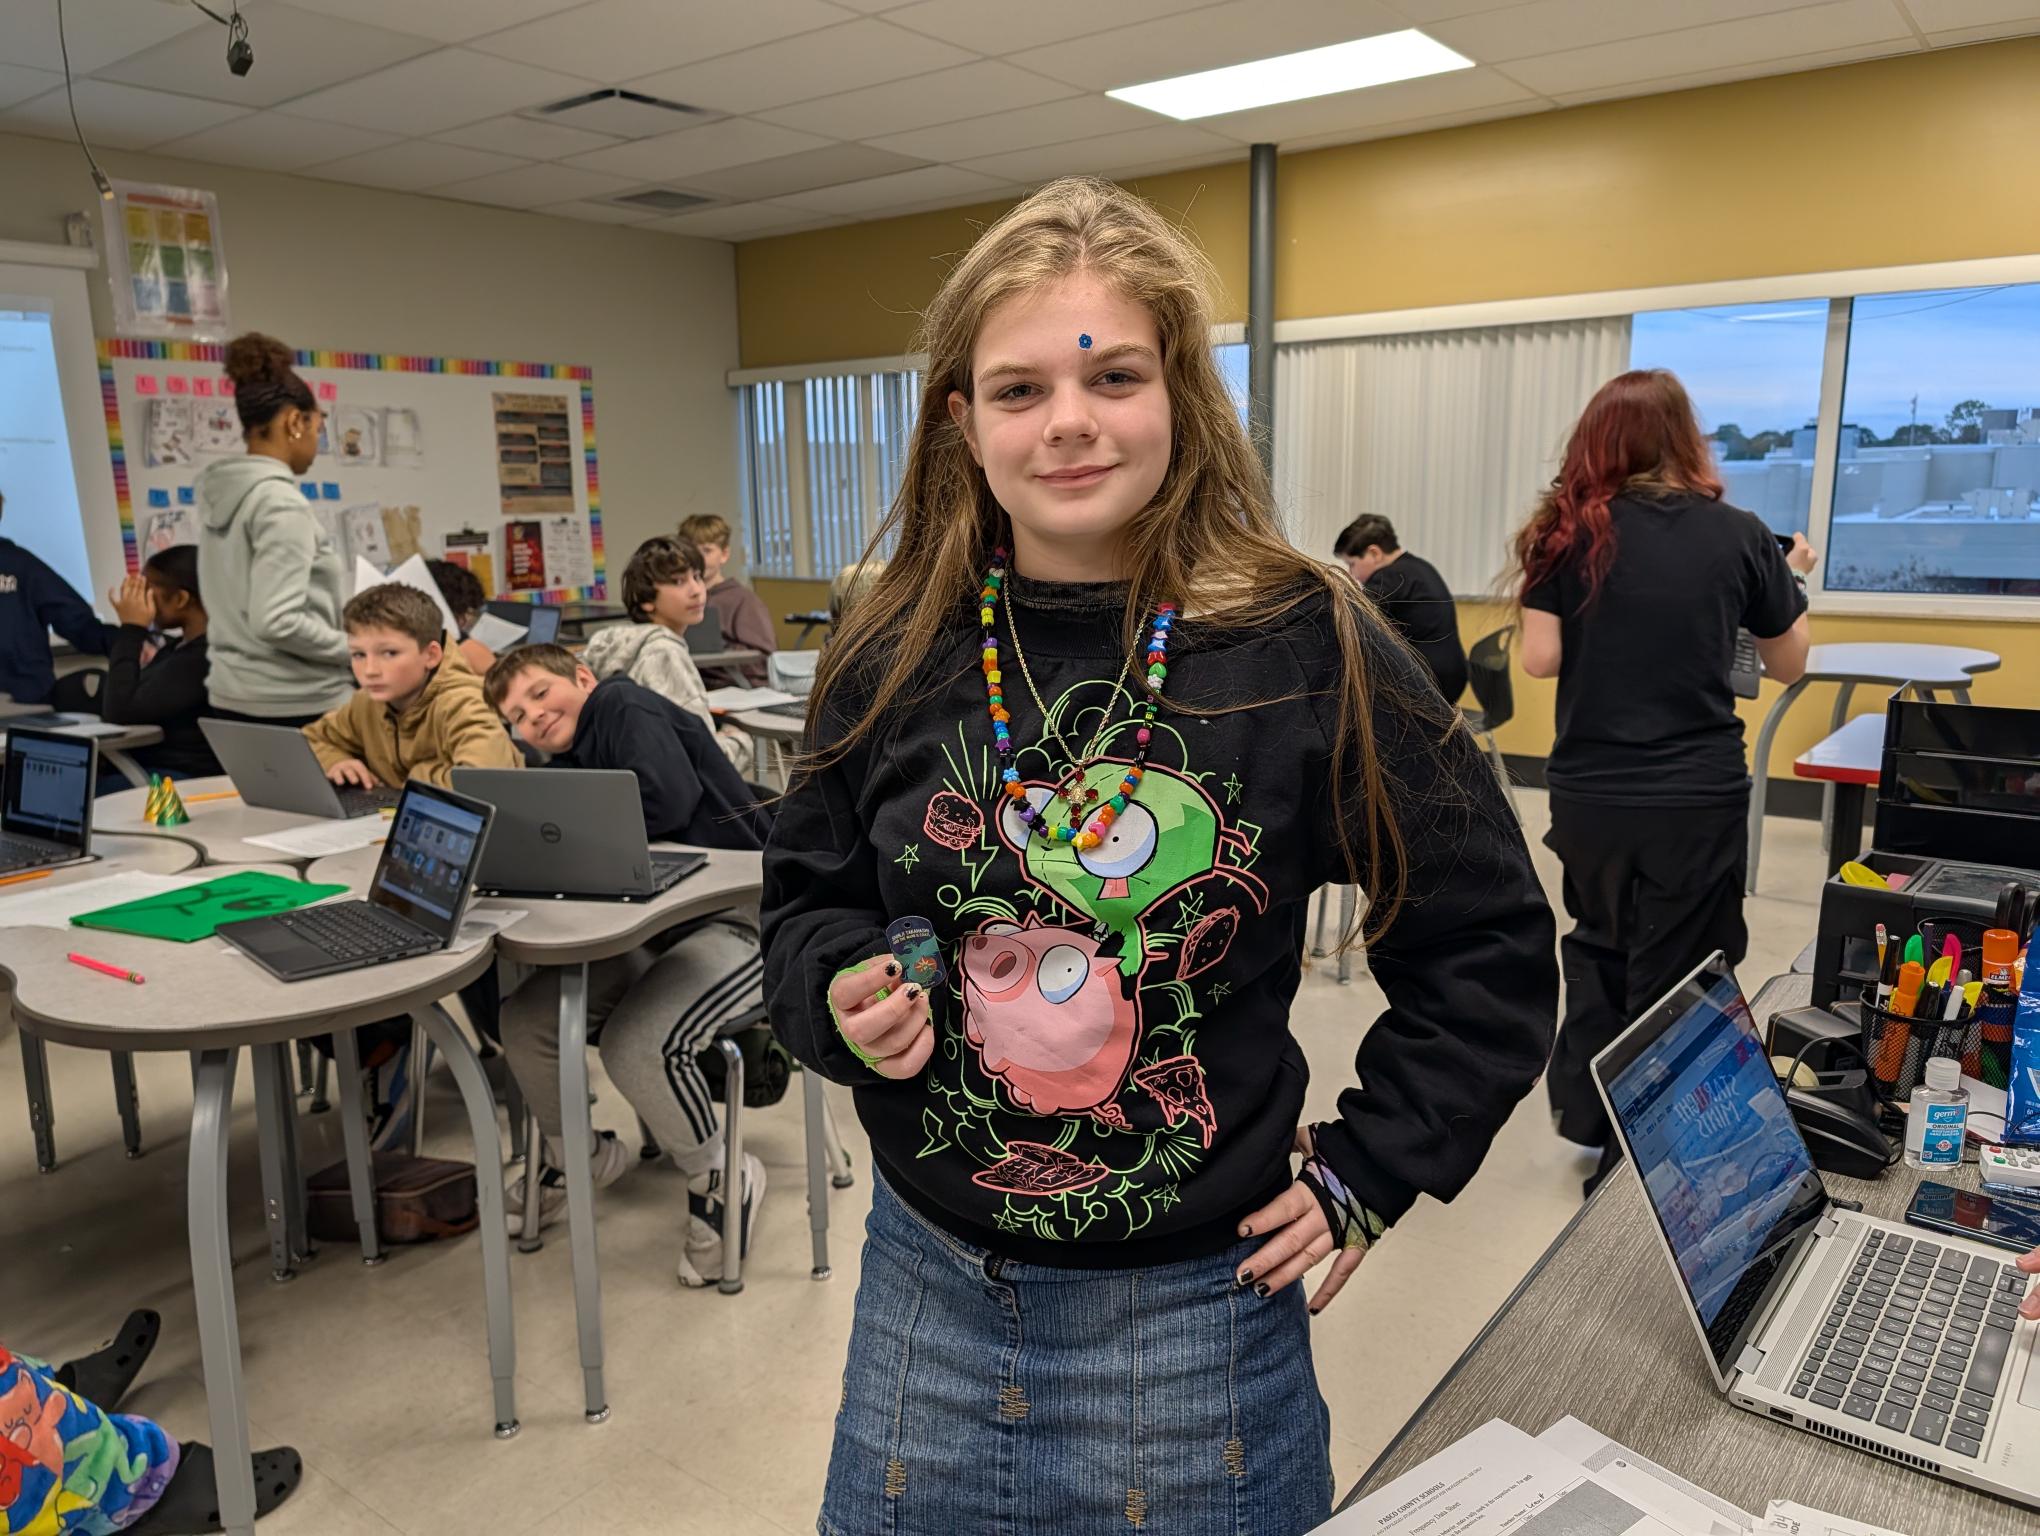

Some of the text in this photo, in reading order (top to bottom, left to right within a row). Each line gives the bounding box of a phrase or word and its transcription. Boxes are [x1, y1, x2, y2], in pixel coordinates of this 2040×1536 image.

[1378, 1482, 1446, 1525] PASCO COUNTY SCHOOLS
